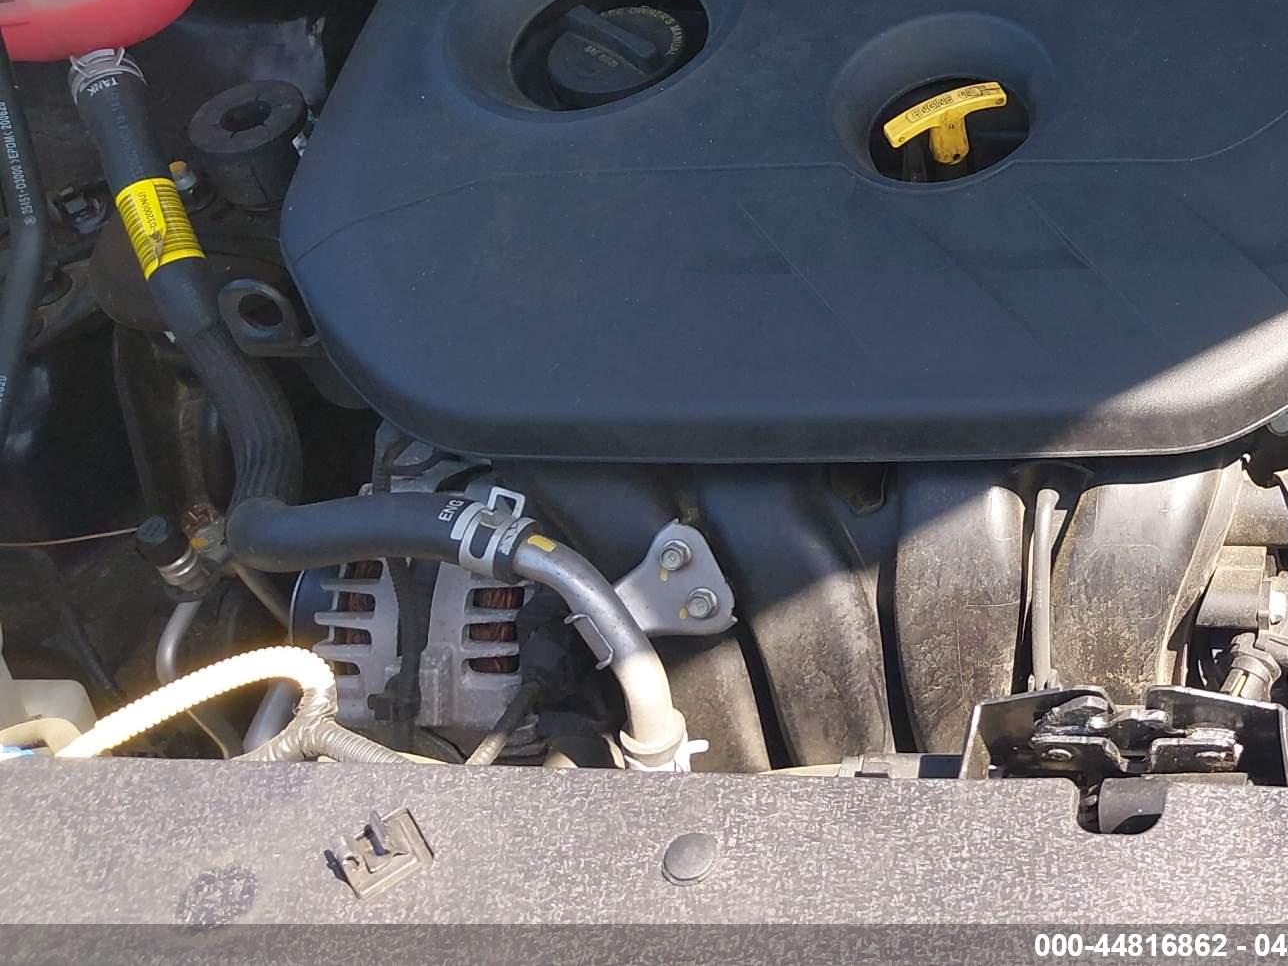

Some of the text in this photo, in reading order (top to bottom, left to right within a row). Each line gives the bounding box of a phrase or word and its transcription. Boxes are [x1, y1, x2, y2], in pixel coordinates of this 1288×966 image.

[86, 76, 120, 97] TANK
[911, 94, 955, 120] ENGINE
[438, 499, 465, 522] ENG
